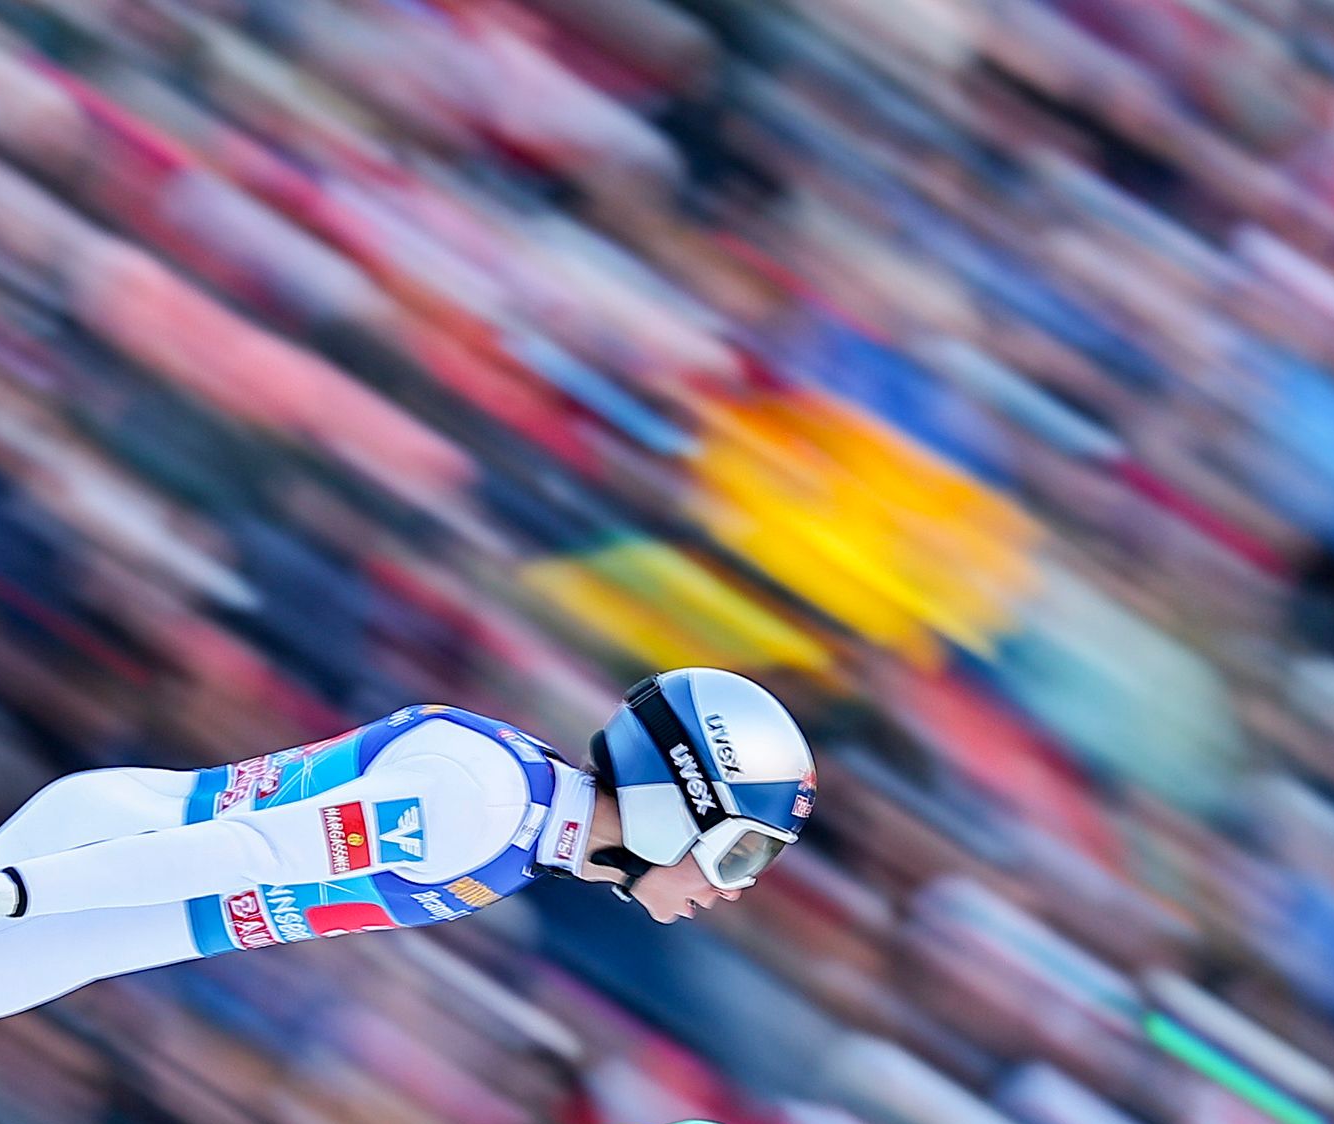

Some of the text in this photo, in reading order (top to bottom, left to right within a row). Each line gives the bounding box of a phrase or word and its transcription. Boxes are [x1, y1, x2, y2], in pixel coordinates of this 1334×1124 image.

[669, 742, 717, 816] uvex
[704, 713, 745, 779] uvex
[324, 806, 351, 874] HARGASSNER
